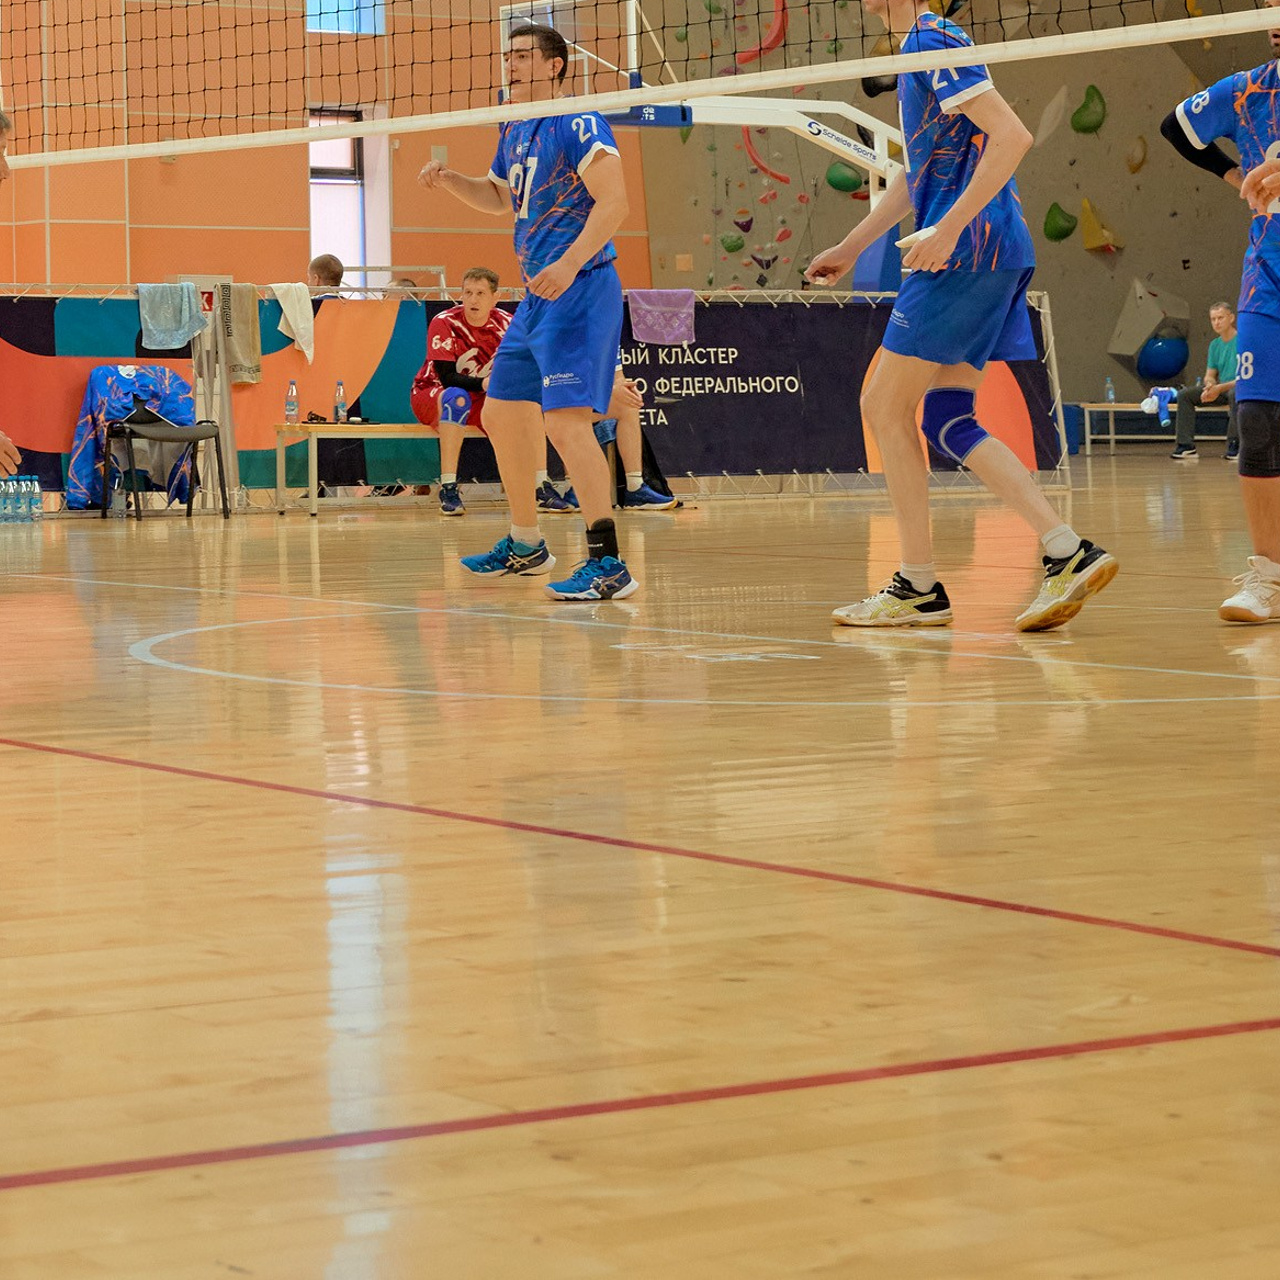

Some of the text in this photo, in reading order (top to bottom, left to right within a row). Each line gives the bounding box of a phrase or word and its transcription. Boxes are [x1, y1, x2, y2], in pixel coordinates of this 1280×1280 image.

[571, 115, 598, 144] 27
[431, 335, 453, 350] 64
[658, 348, 738, 365] КЛАСТЕР
[655, 376, 799, 396] ФЕДЕРАЛЬНОГО
